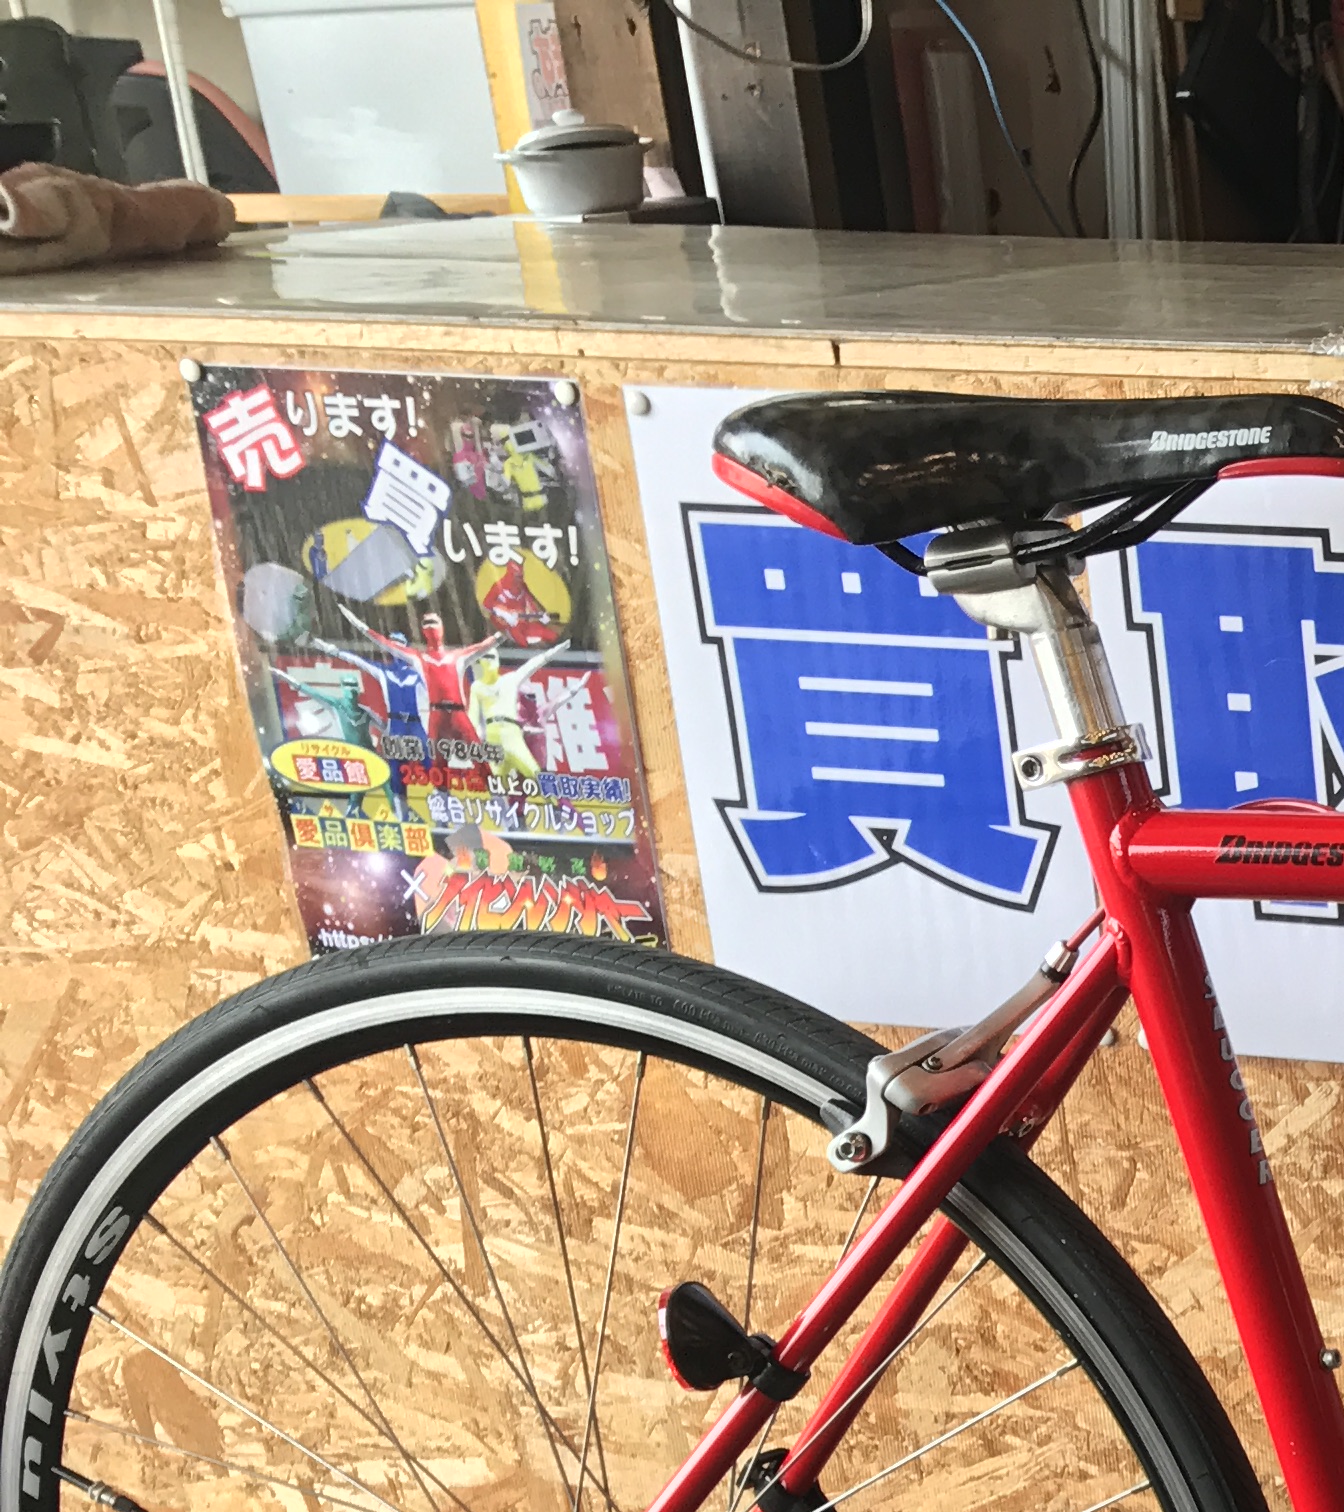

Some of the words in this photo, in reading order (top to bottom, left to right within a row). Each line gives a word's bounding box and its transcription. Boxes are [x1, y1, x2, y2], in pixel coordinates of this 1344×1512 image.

[204, 386, 421, 492] 売ります!
[1149, 425, 1272, 452] BRIDGESTONE
[361, 440, 582, 571] 買います!
